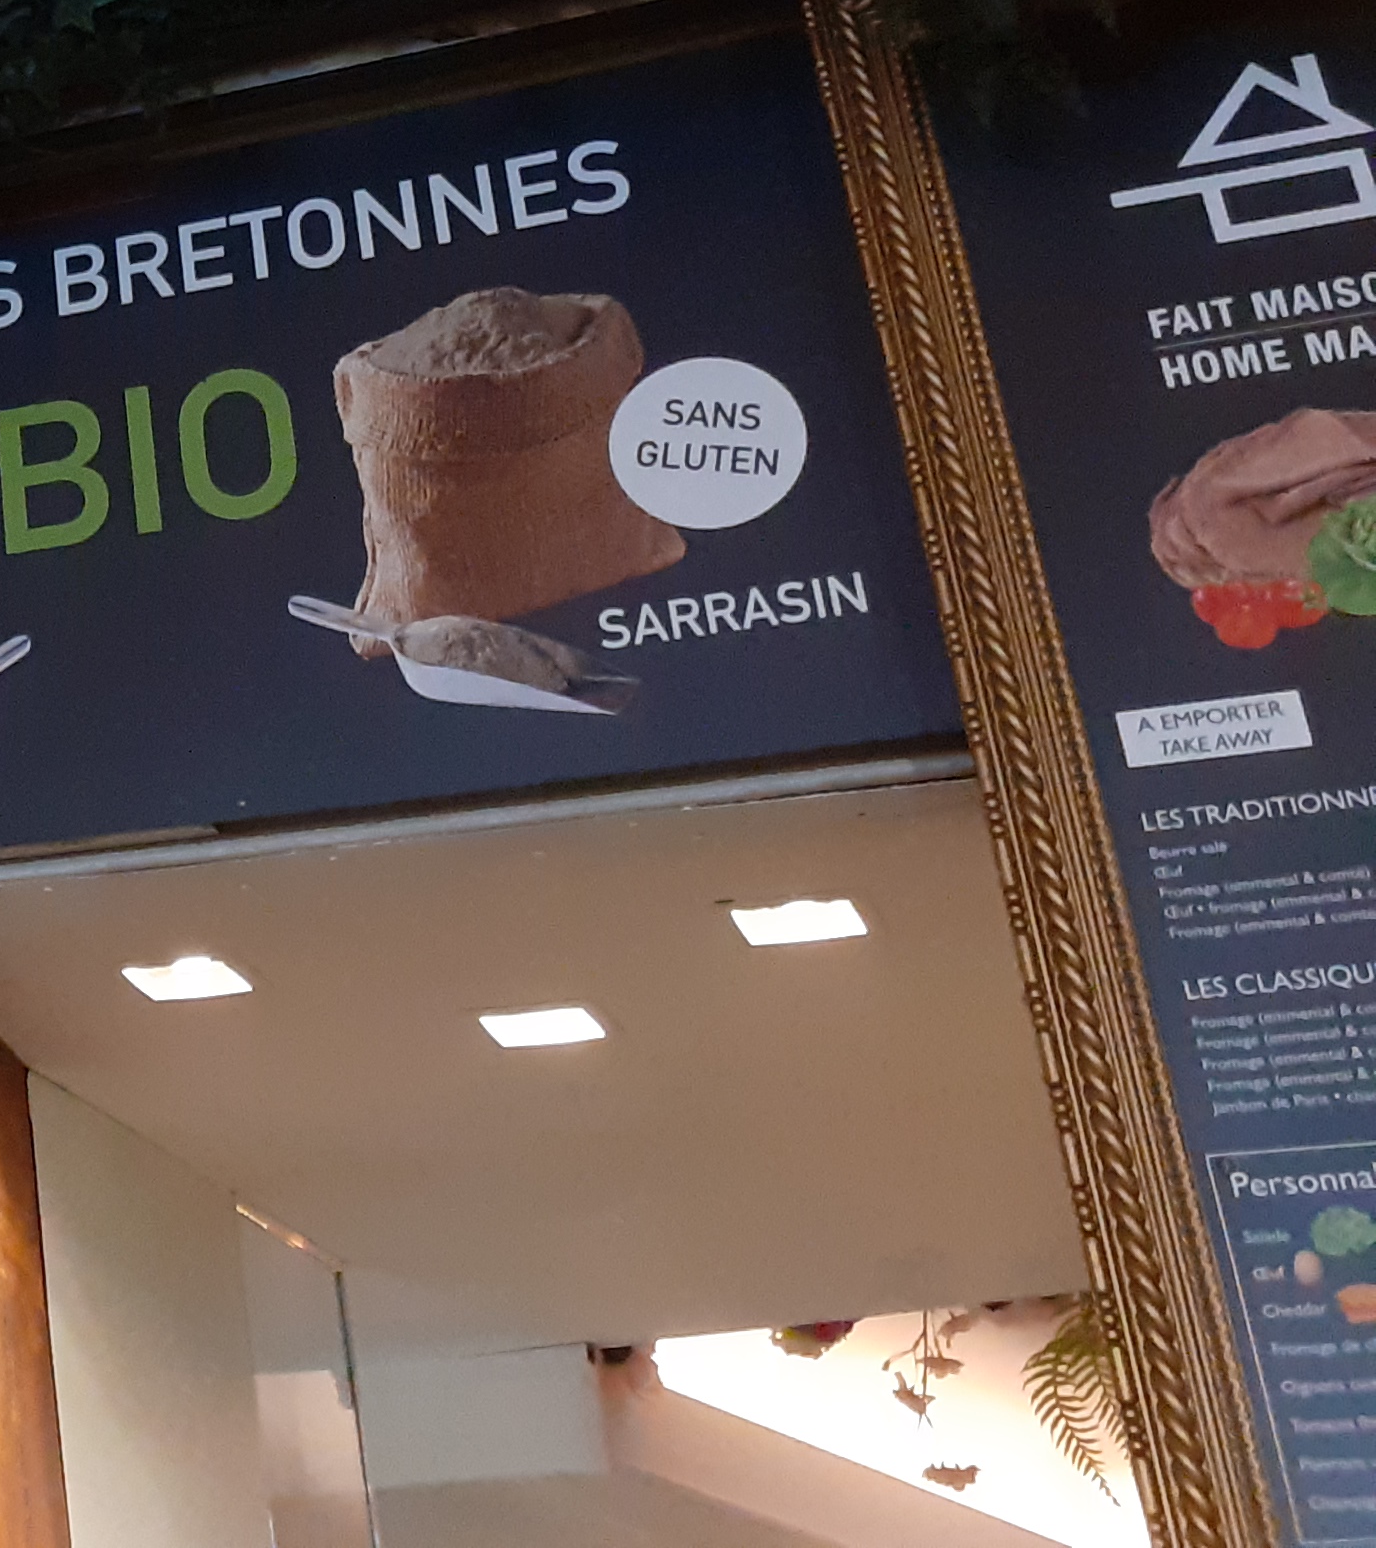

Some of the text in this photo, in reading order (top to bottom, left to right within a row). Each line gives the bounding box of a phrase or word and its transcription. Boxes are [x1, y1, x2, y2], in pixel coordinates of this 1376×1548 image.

[53, 140, 632, 318] BRETONNES
[1147, 297, 1233, 339] FAIT
[1160, 338, 1292, 389] HOME
[663, 398, 762, 432] SANS
[635, 438, 780, 478] GLUTEN
[598, 571, 870, 652] SARRASIN
[1137, 699, 1284, 734] A EMPORTER
[1159, 728, 1274, 757] TAKE AWAY
[1140, 808, 1184, 832] LES
[1182, 960, 1376, 1001] LES CLASSIQU
